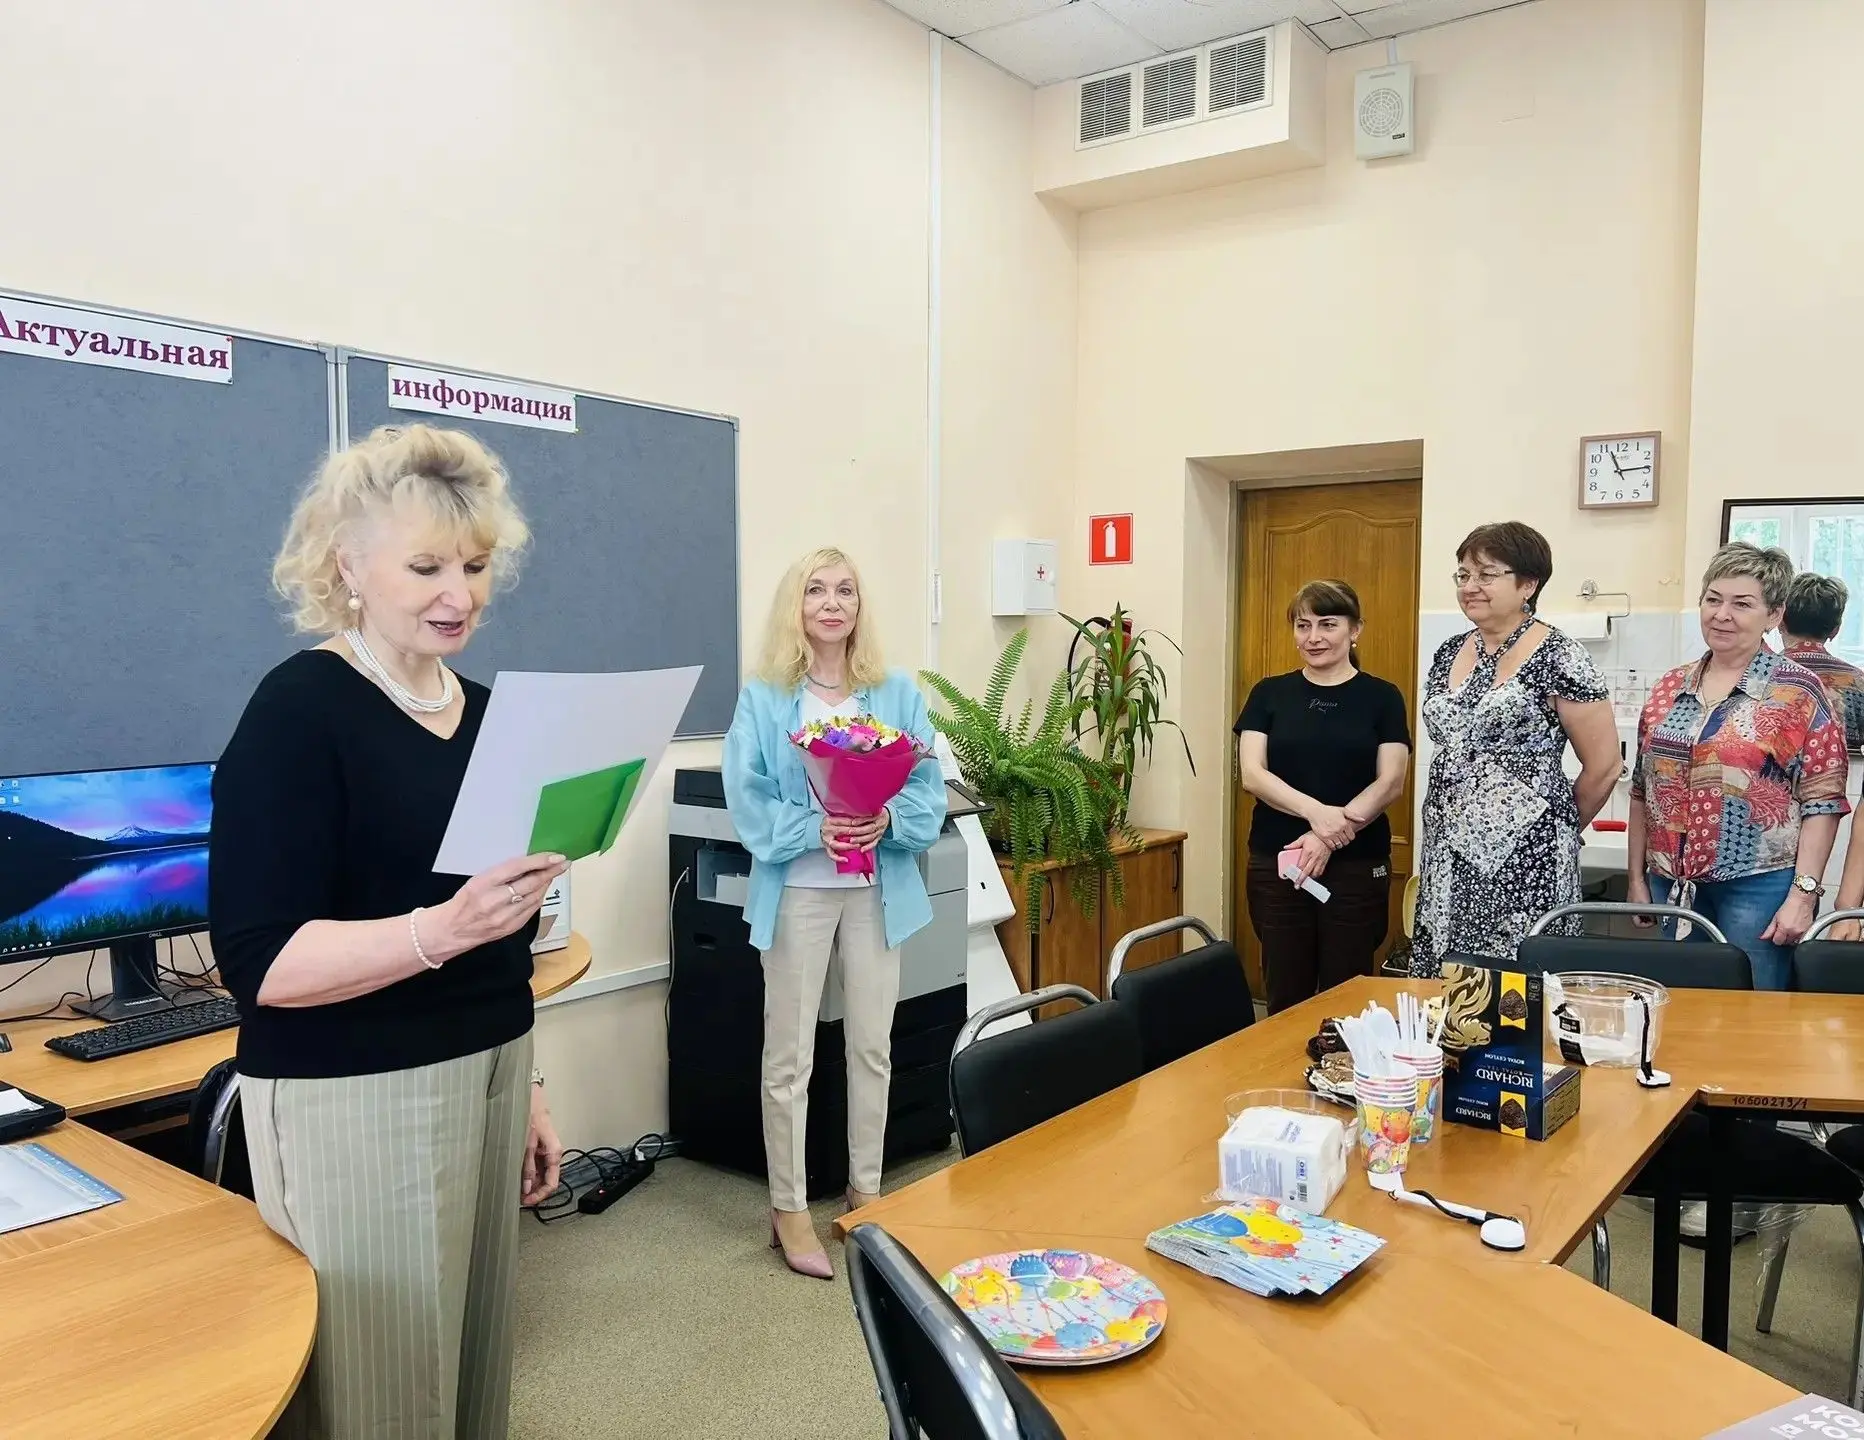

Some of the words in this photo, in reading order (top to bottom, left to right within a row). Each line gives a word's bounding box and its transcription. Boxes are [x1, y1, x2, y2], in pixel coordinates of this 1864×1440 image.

[392, 378, 572, 421] информация
[1600, 444, 1608, 453] 11
[1616, 442, 1629, 452] 12
[1591, 453, 1602, 463] 10
[1643, 450, 1651, 460] 2
[1590, 468, 1598, 477] 9
[1589, 481, 1597, 491] 8
[1642, 479, 1650, 489] 4
[1600, 491, 1607, 500] 7
[1615, 490, 1623, 500] 6
[1631, 489, 1640, 499] 5
[1485, 1053, 1507, 1061] CEYLON
[1507, 1056, 1525, 1065] ROYAL
[1476, 1068, 1534, 1088] RICHARD
[1455, 1106, 1492, 1120] RICHARD
[1810, 1405, 1864, 1433] КО
[1792, 1413, 1863, 1440] МО
